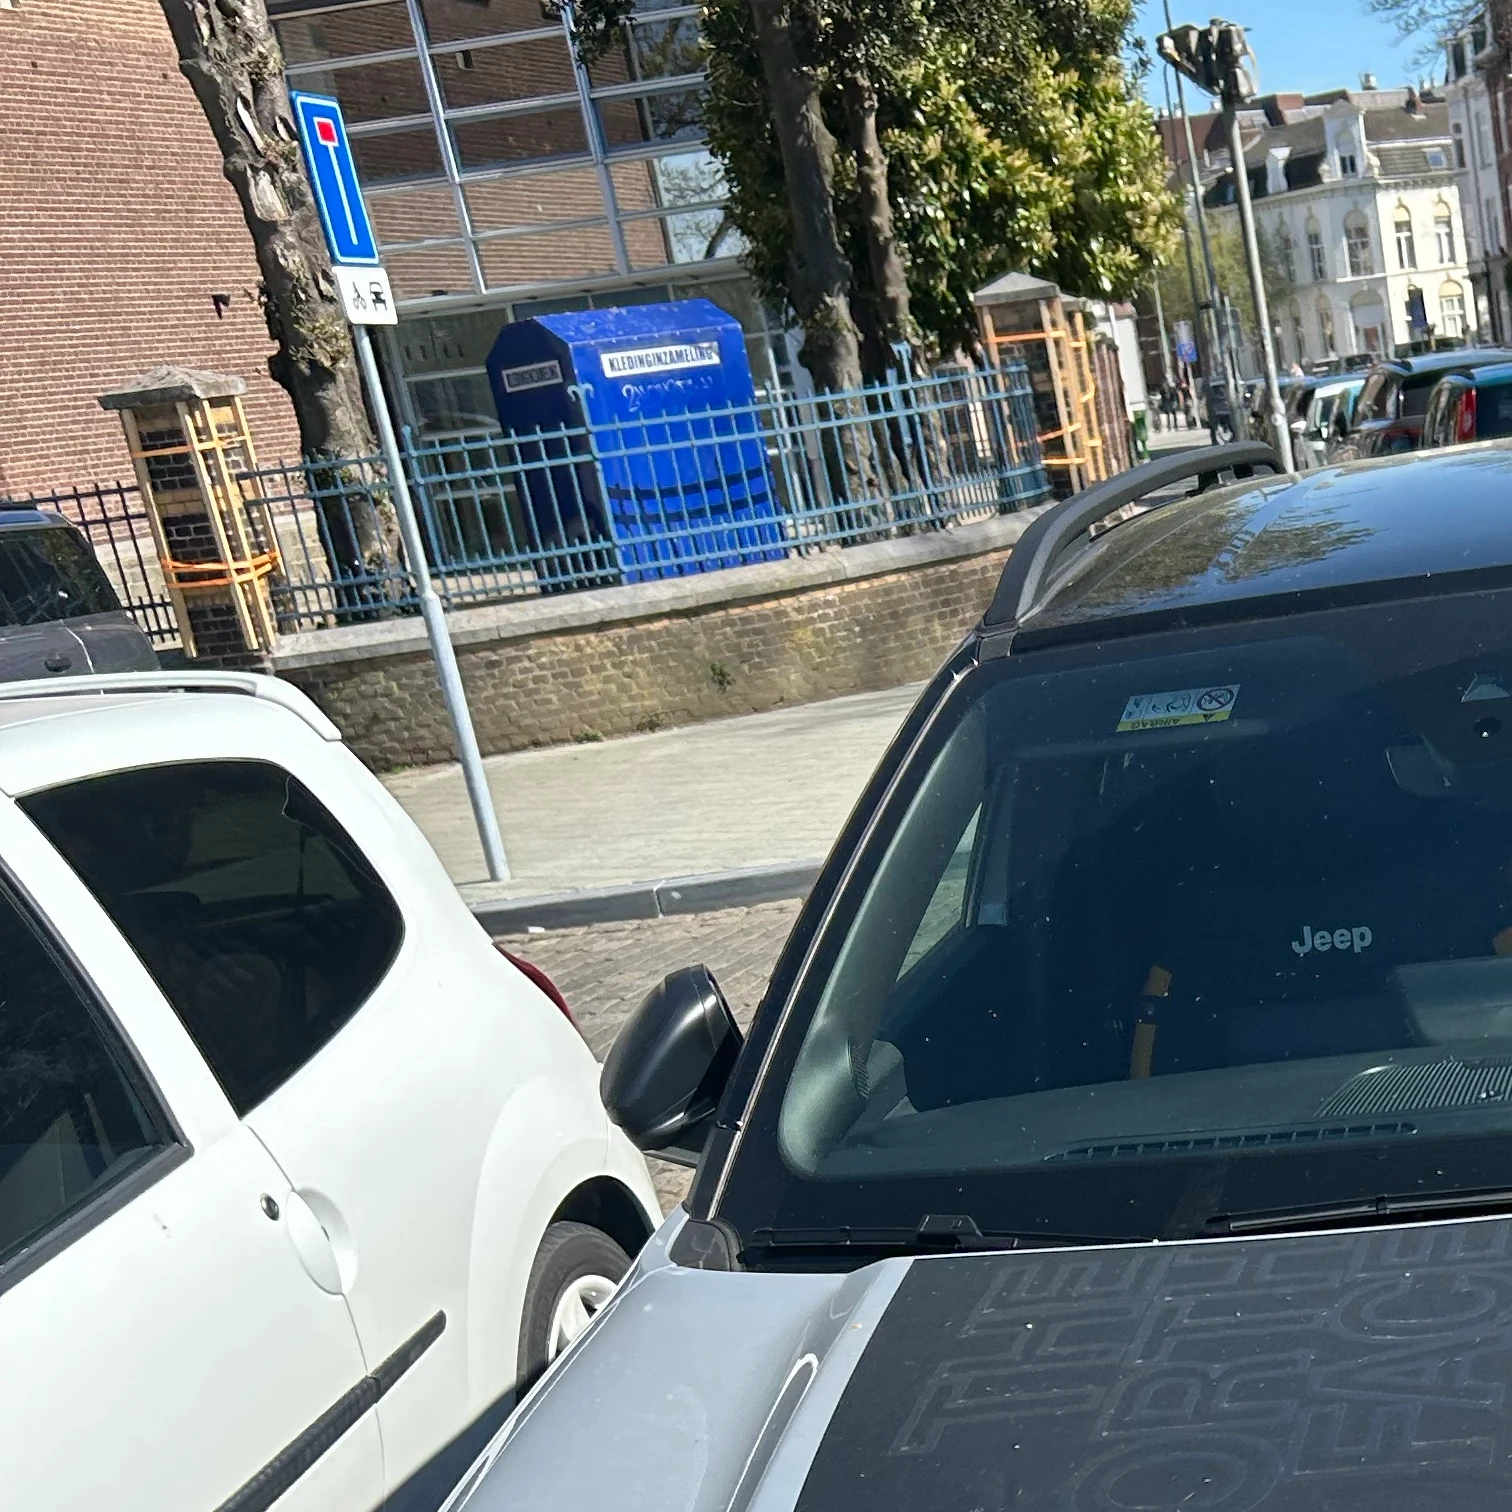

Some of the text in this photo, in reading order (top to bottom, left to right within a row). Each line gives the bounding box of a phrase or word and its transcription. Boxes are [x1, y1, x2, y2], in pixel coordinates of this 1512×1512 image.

[608, 346, 713, 373] KLEDINGINZAMELING
[1291, 925, 1373, 955] Jeep
[887, 1252, 1147, 1457] THE
